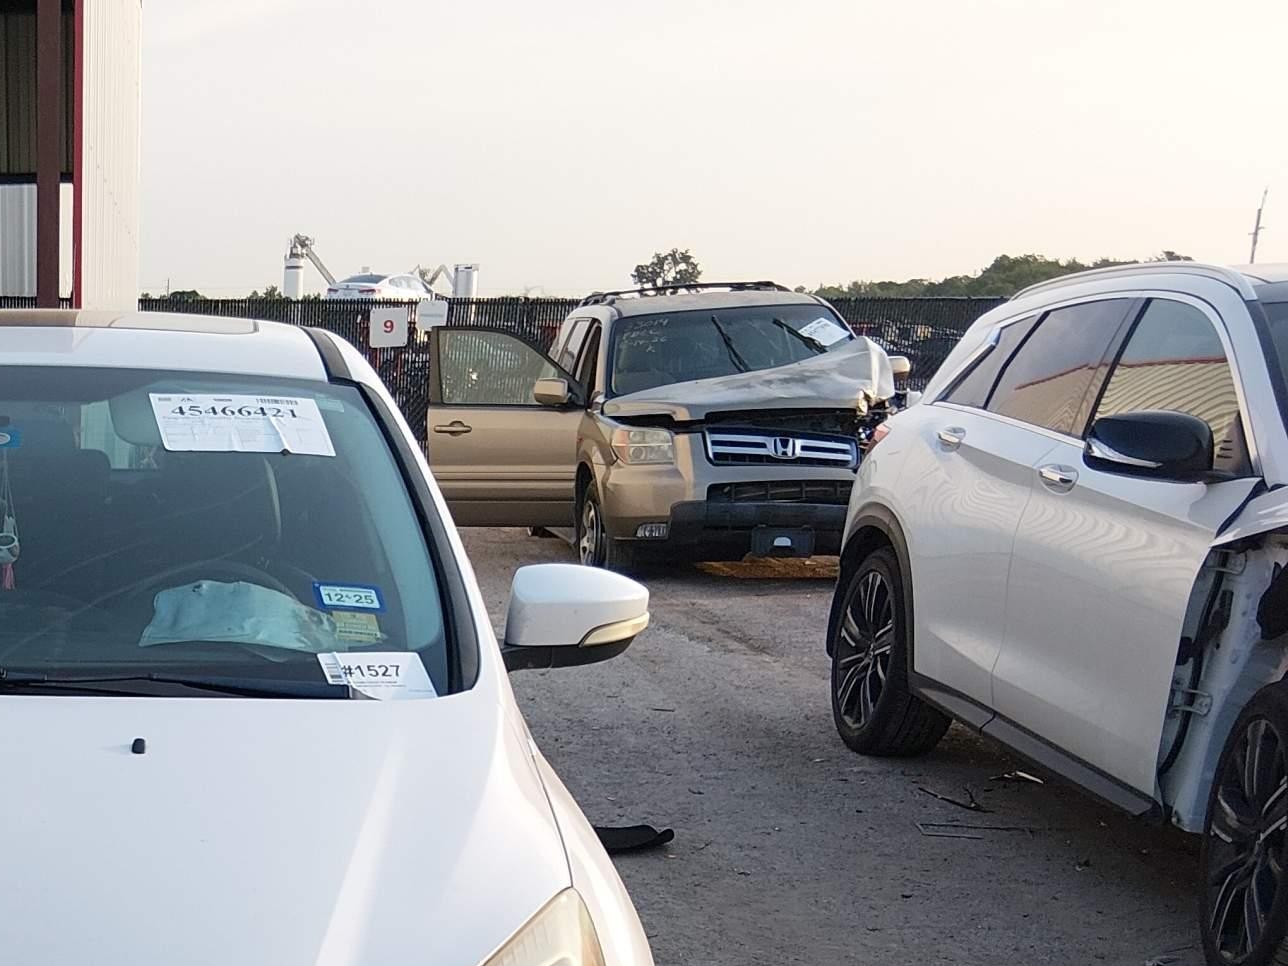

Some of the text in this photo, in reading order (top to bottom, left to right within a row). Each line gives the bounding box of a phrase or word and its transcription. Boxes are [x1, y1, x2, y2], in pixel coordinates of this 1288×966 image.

[383, 319, 395, 334] 9
[170, 404, 299, 420] 45466421
[340, 664, 401, 678] #1527
